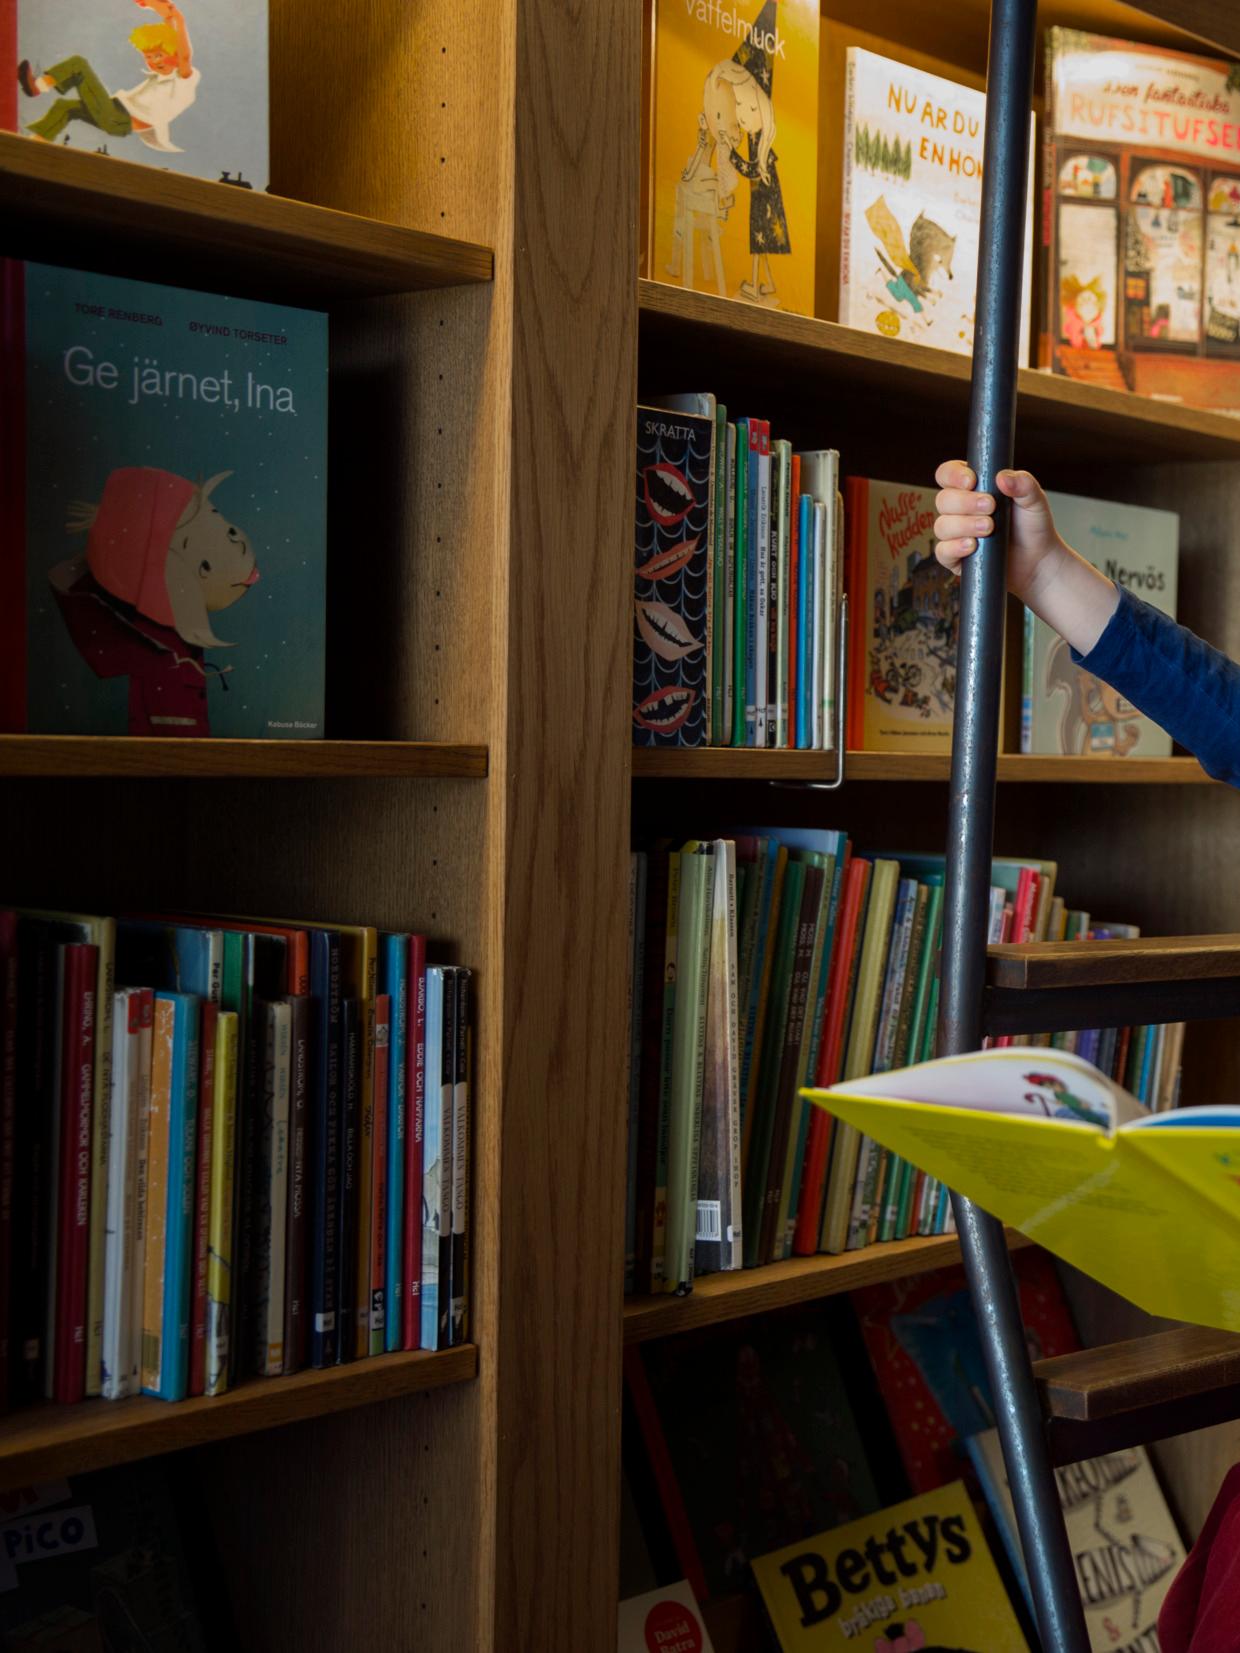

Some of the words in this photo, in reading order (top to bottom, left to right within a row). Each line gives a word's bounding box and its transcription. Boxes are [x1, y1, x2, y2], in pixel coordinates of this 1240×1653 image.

[888, 81, 917, 114] NU
[953, 110, 979, 138] DU
[920, 136, 944, 166] EN
[75, 302, 106, 317] TORE
[108, 307, 163, 327] RENBERG
[189, 320, 231, 338] ØYVIND
[233, 328, 289, 346] TORSETER
[63, 345, 119, 390] Ge
[128, 355, 240, 413] järnet,
[247, 371, 297, 414] Ina
[645, 420, 697, 442] SKRATTA
[780, 1515, 972, 1628] Bettys
[653, 1619, 691, 1645] David
